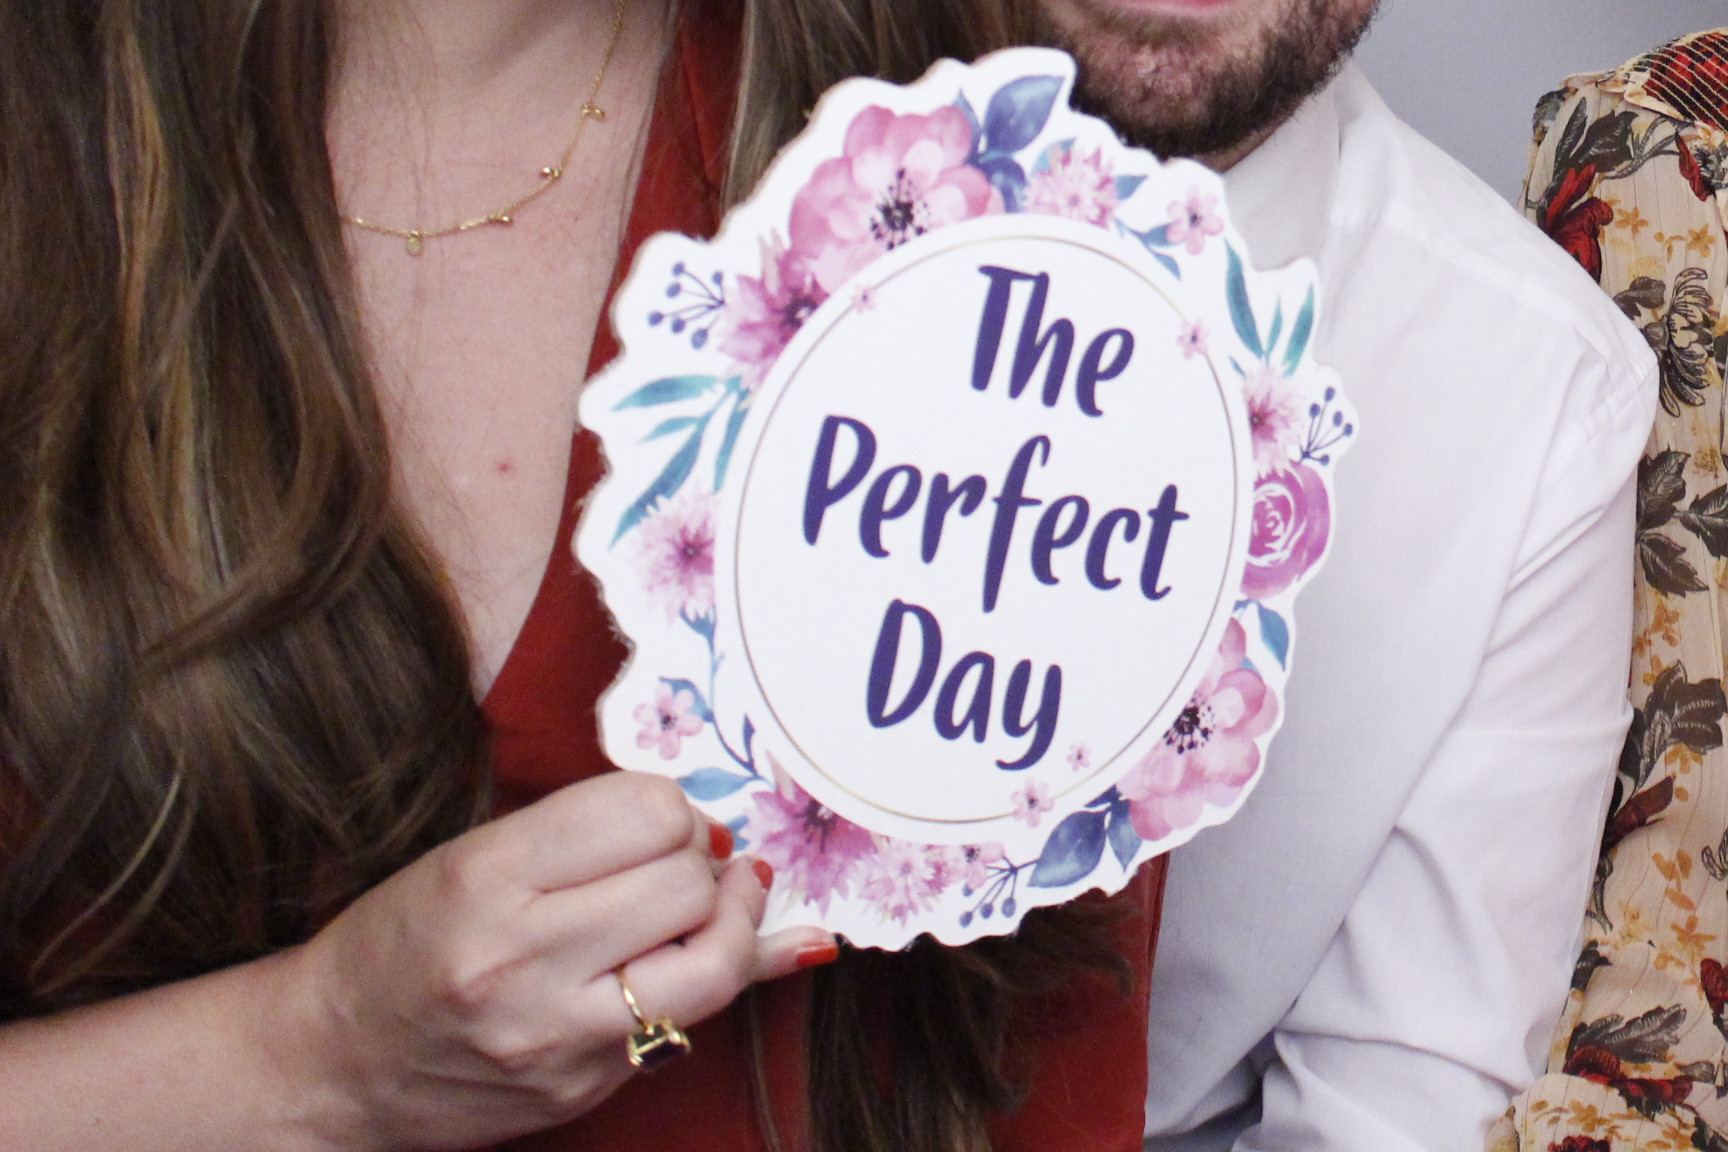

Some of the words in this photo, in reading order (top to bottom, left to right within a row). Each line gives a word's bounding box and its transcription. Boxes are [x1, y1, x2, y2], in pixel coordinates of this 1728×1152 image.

[968, 264, 1136, 417] The
[802, 413, 1190, 614] Perfect
[865, 598, 1063, 771] Day
